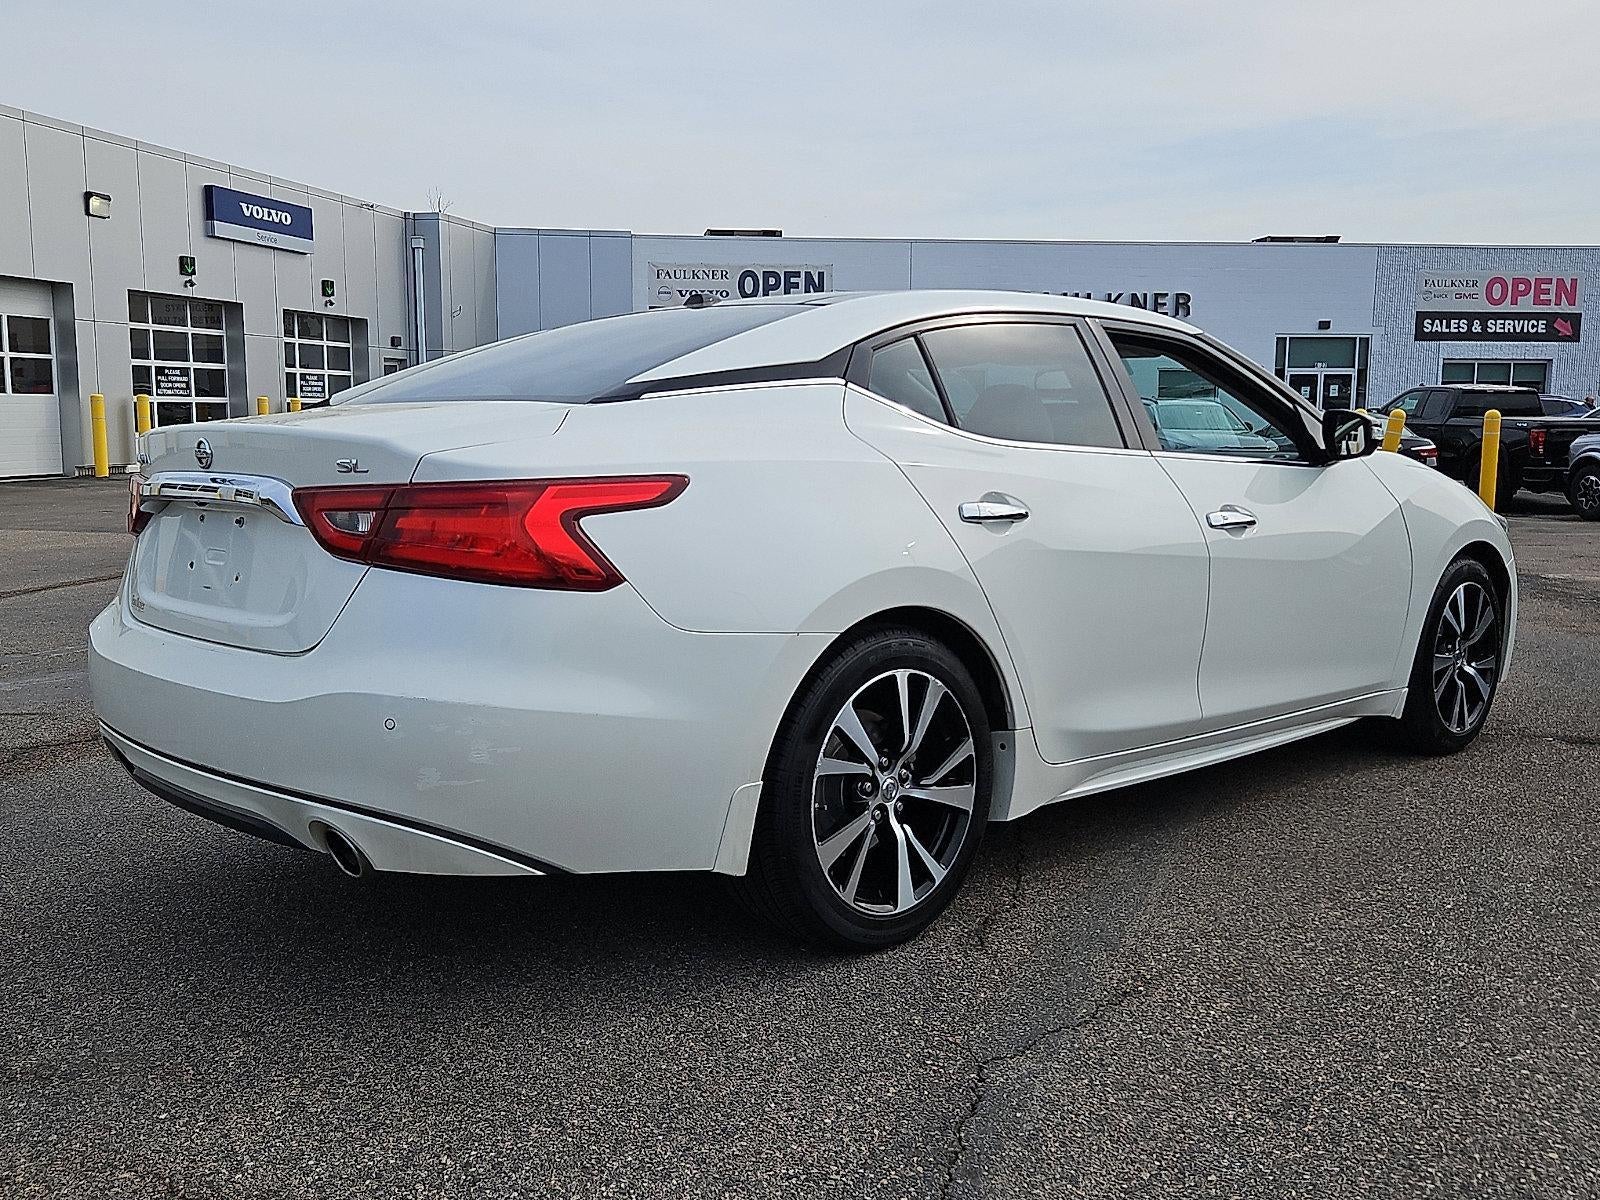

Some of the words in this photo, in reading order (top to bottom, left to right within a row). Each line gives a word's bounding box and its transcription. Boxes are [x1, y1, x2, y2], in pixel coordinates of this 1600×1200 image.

[239, 202, 292, 226] VOLVO
[256, 232, 278, 245] Service
[656, 269, 730, 280] FAULKNER
[738, 269, 825, 299] OPEN
[1424, 279, 1479, 288] FAULKNER
[1454, 292, 1479, 300] GMC
[1485, 276, 1578, 307] OPEN
[1423, 319, 1468, 333] SALES
[1471, 320, 1482, 333] &
[1486, 320, 1547, 333] SERVICE
[336, 459, 370, 473] SL
